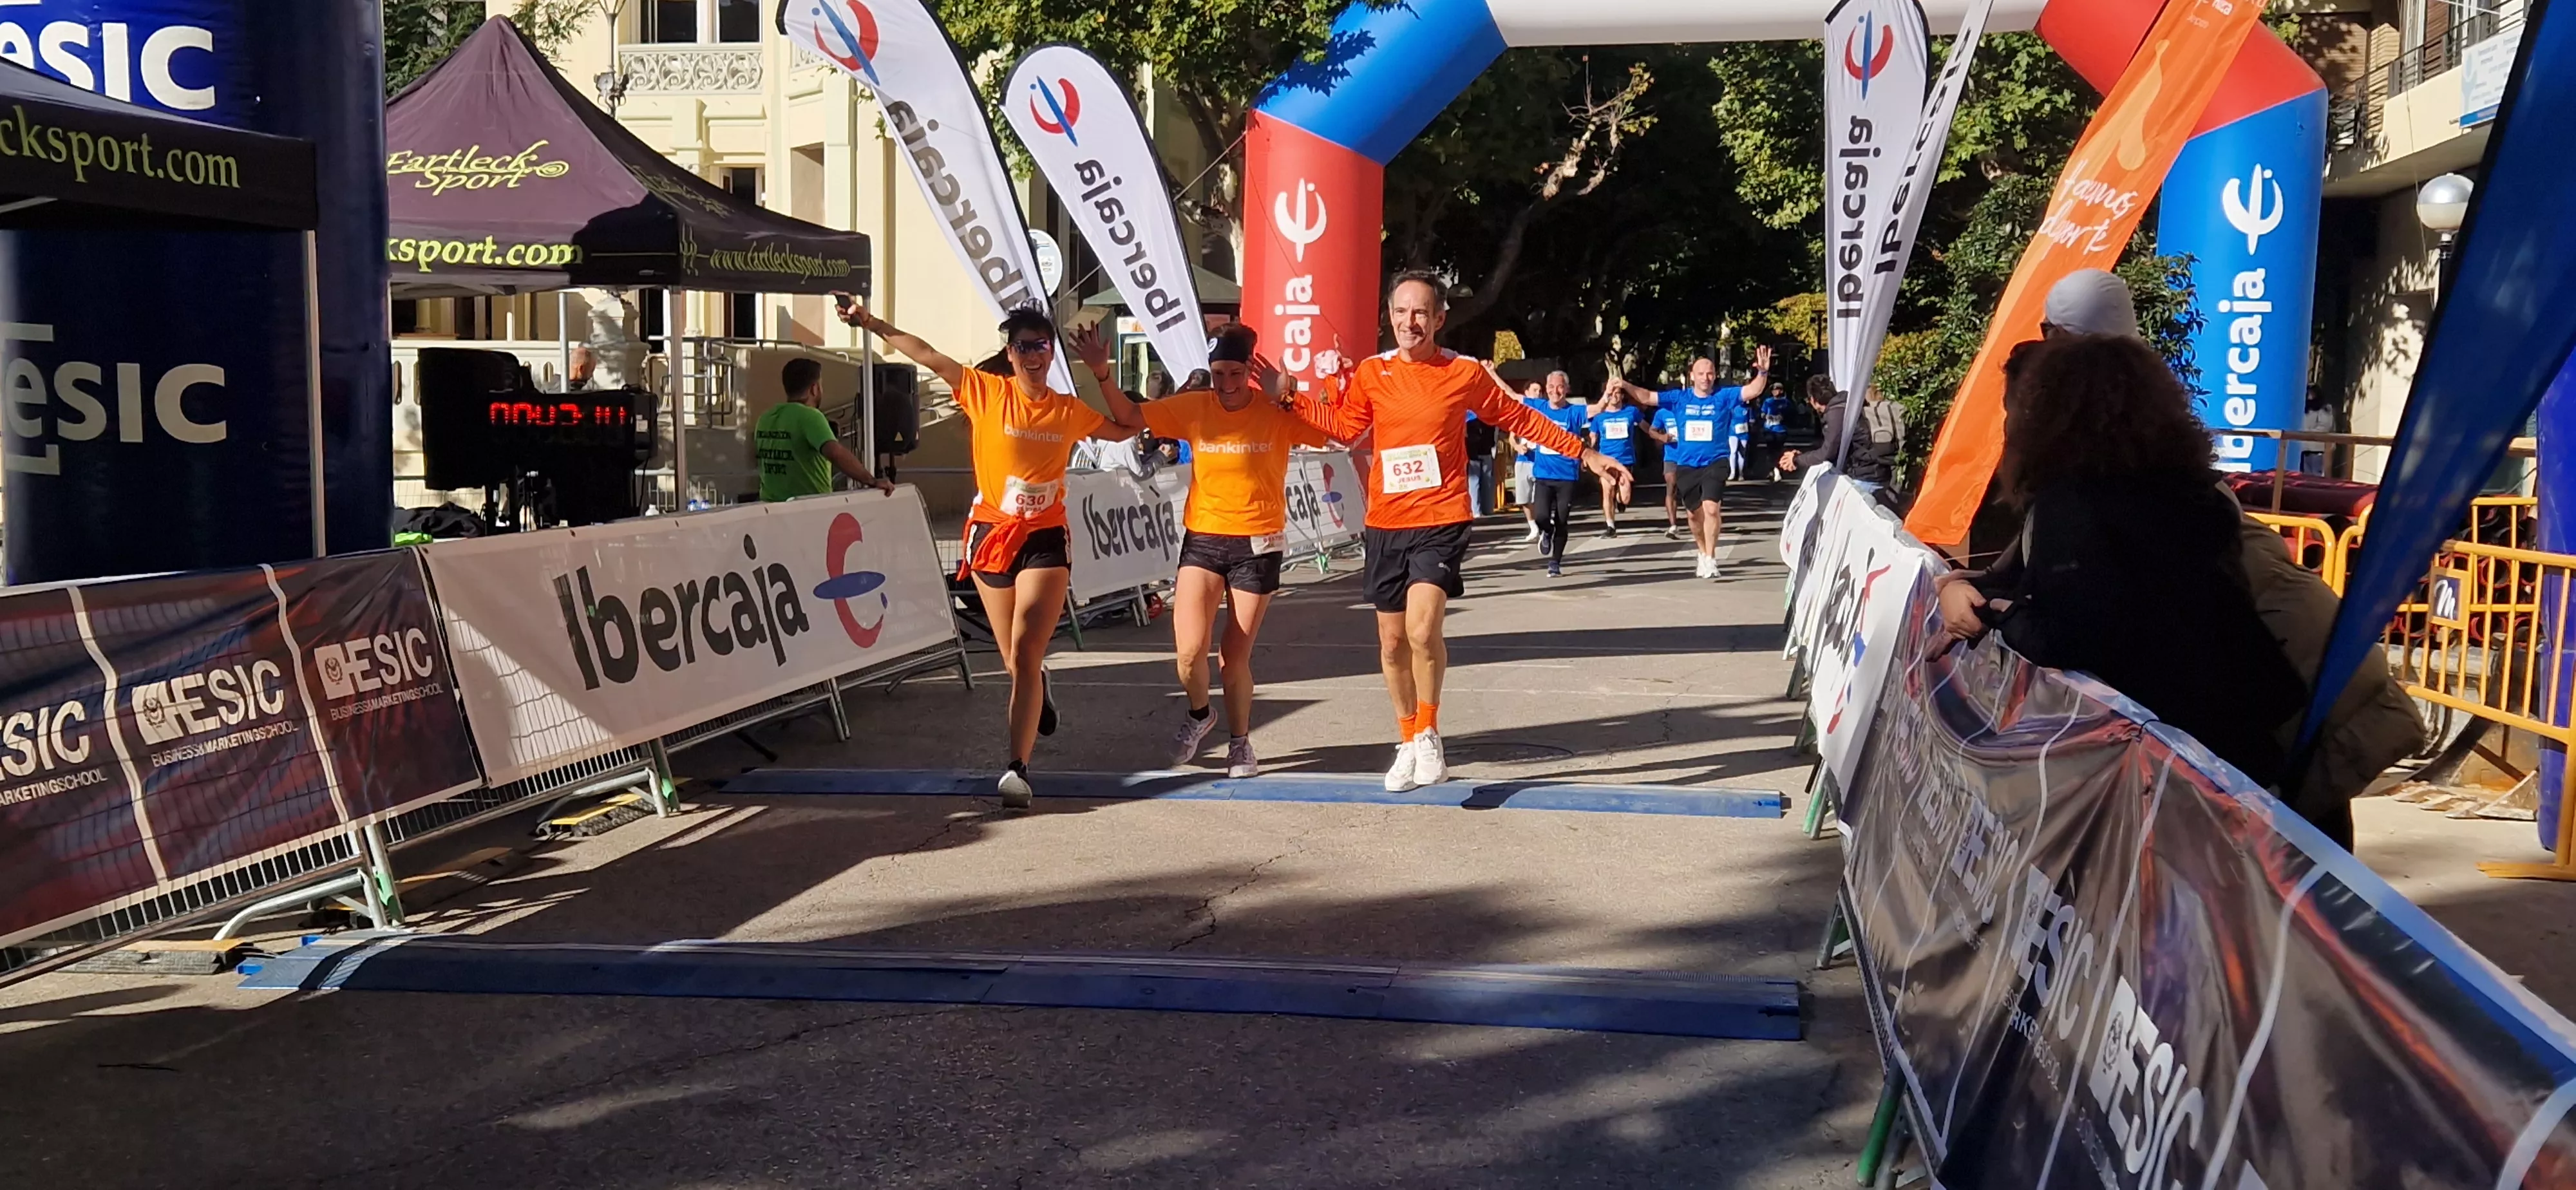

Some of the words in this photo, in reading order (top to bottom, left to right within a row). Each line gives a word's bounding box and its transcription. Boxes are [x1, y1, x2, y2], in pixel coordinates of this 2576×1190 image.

[415, 166, 527, 196] Sport
[1015, 493, 1046, 506] 630
[1393, 460, 1425, 476] 632
[1083, 485, 1180, 562] Ibercaja
[553, 533, 810, 691] Ibercaja
[345, 628, 433, 693] ESIC
[169, 659, 285, 735] ESIC
[0, 700, 90, 781] SIC
